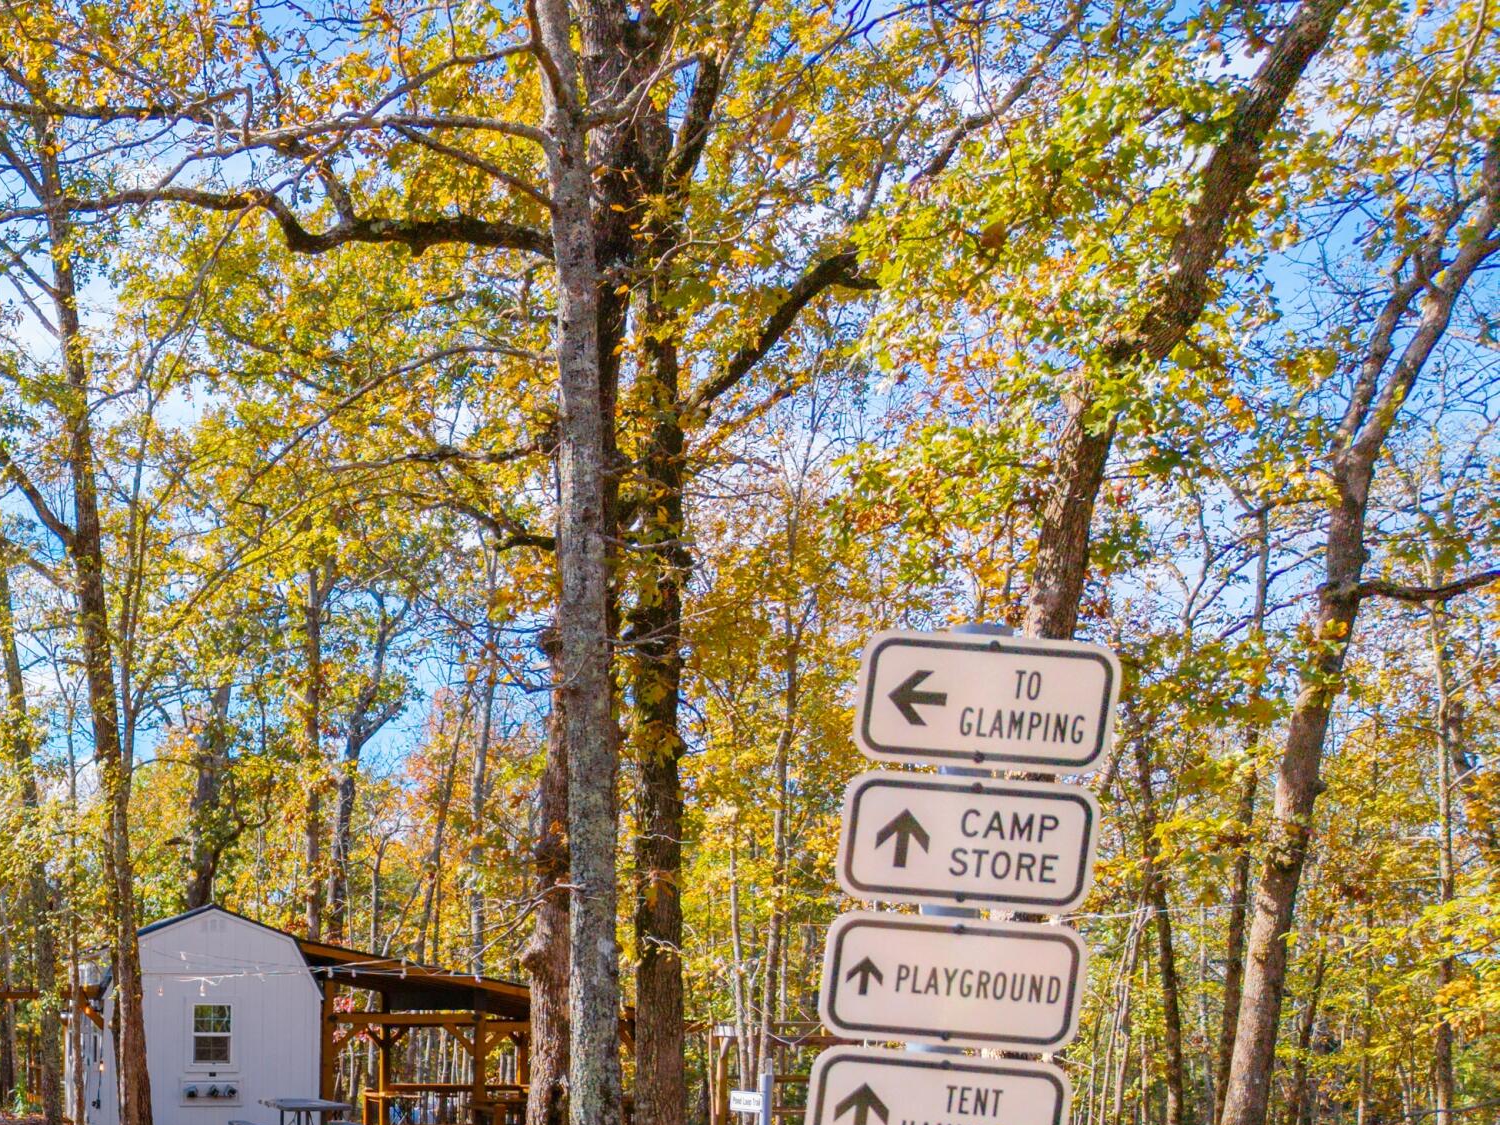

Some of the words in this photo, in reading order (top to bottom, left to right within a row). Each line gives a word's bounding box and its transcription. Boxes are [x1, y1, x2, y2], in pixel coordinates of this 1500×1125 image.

[1015, 669, 1042, 701] TO
[959, 706, 1086, 745] GLAMPING
[961, 808, 1060, 843] CAMP
[948, 847, 1059, 884] STORE
[894, 964, 1062, 1005] PLAYGROUND
[946, 1085, 1004, 1118] TENT
